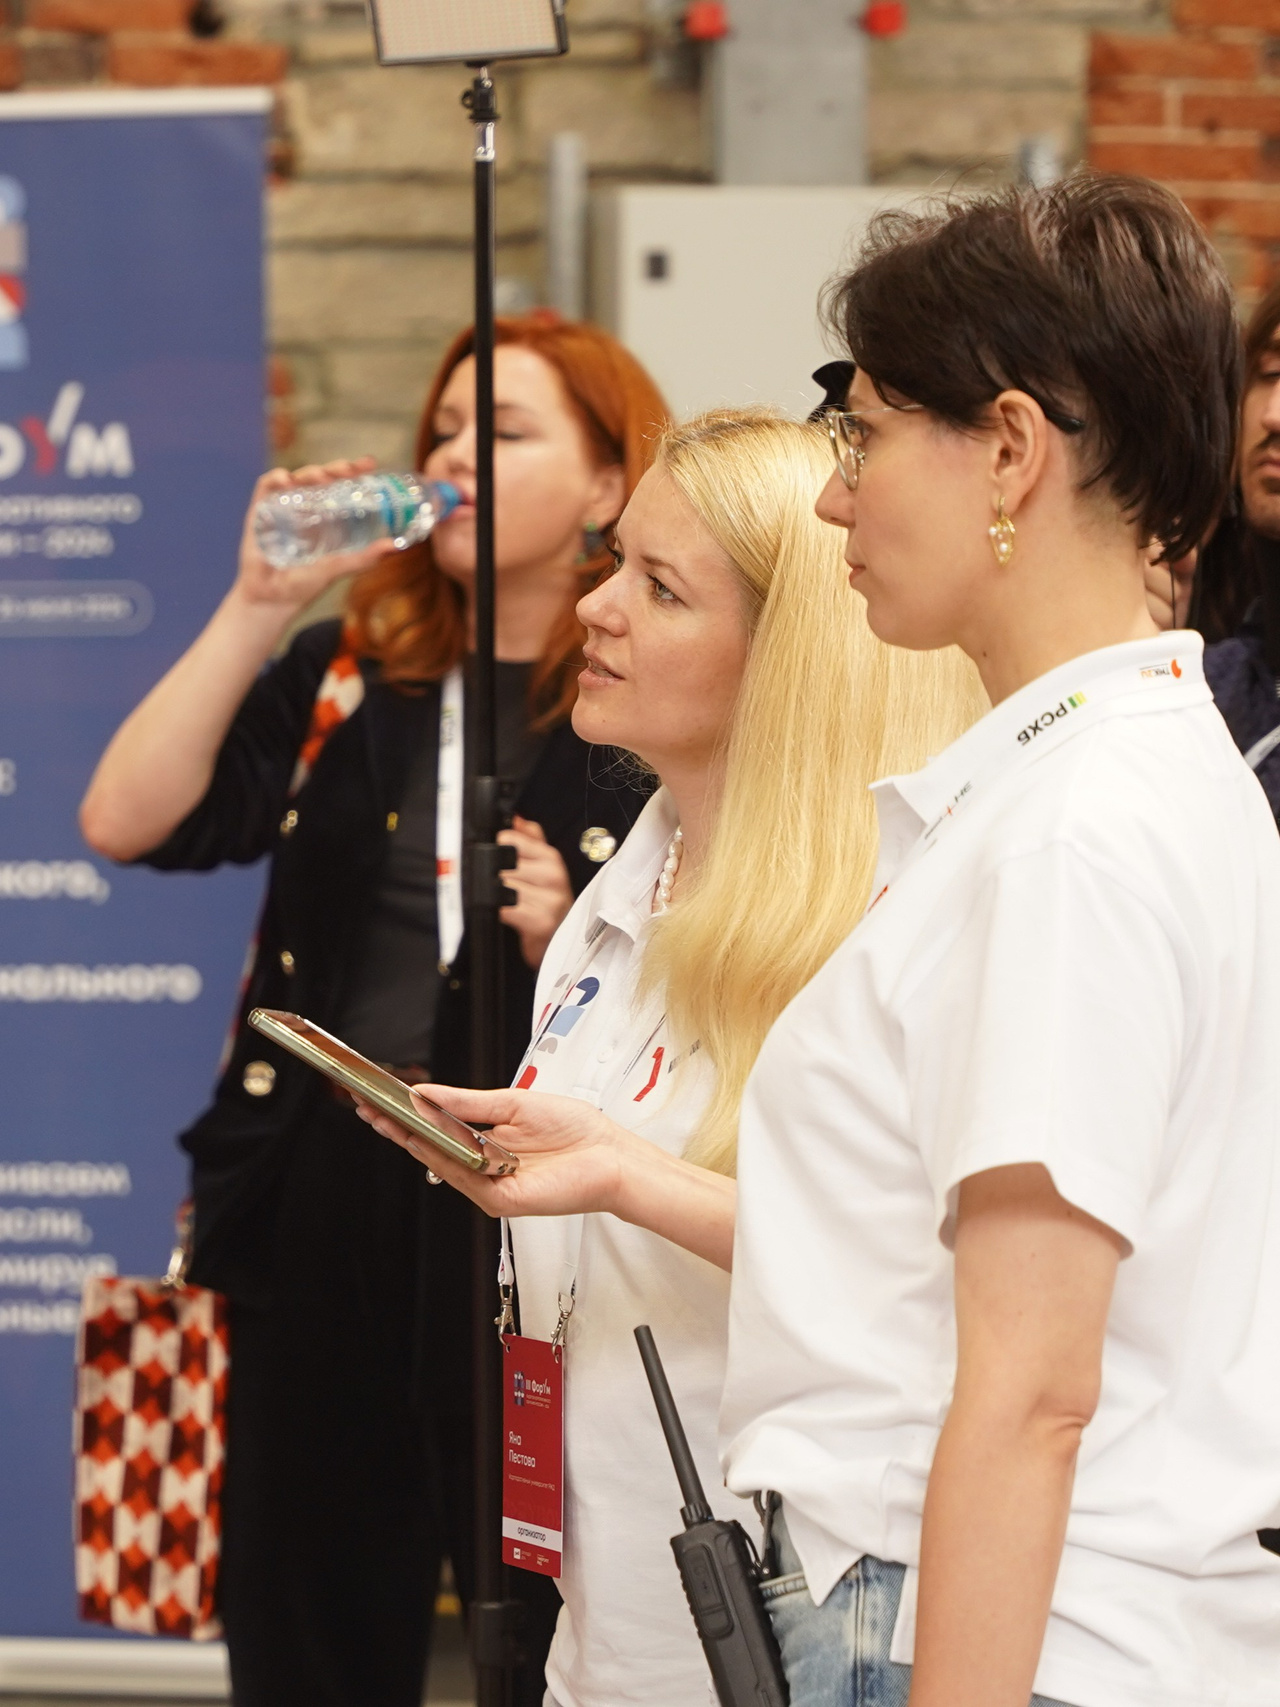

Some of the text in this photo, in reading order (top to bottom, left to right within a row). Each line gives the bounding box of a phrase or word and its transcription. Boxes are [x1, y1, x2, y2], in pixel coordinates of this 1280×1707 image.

[1017, 702, 1068, 746] РСХБ
[509, 1430, 522, 1446] Яна
[509, 1449, 536, 1468] Пестова
